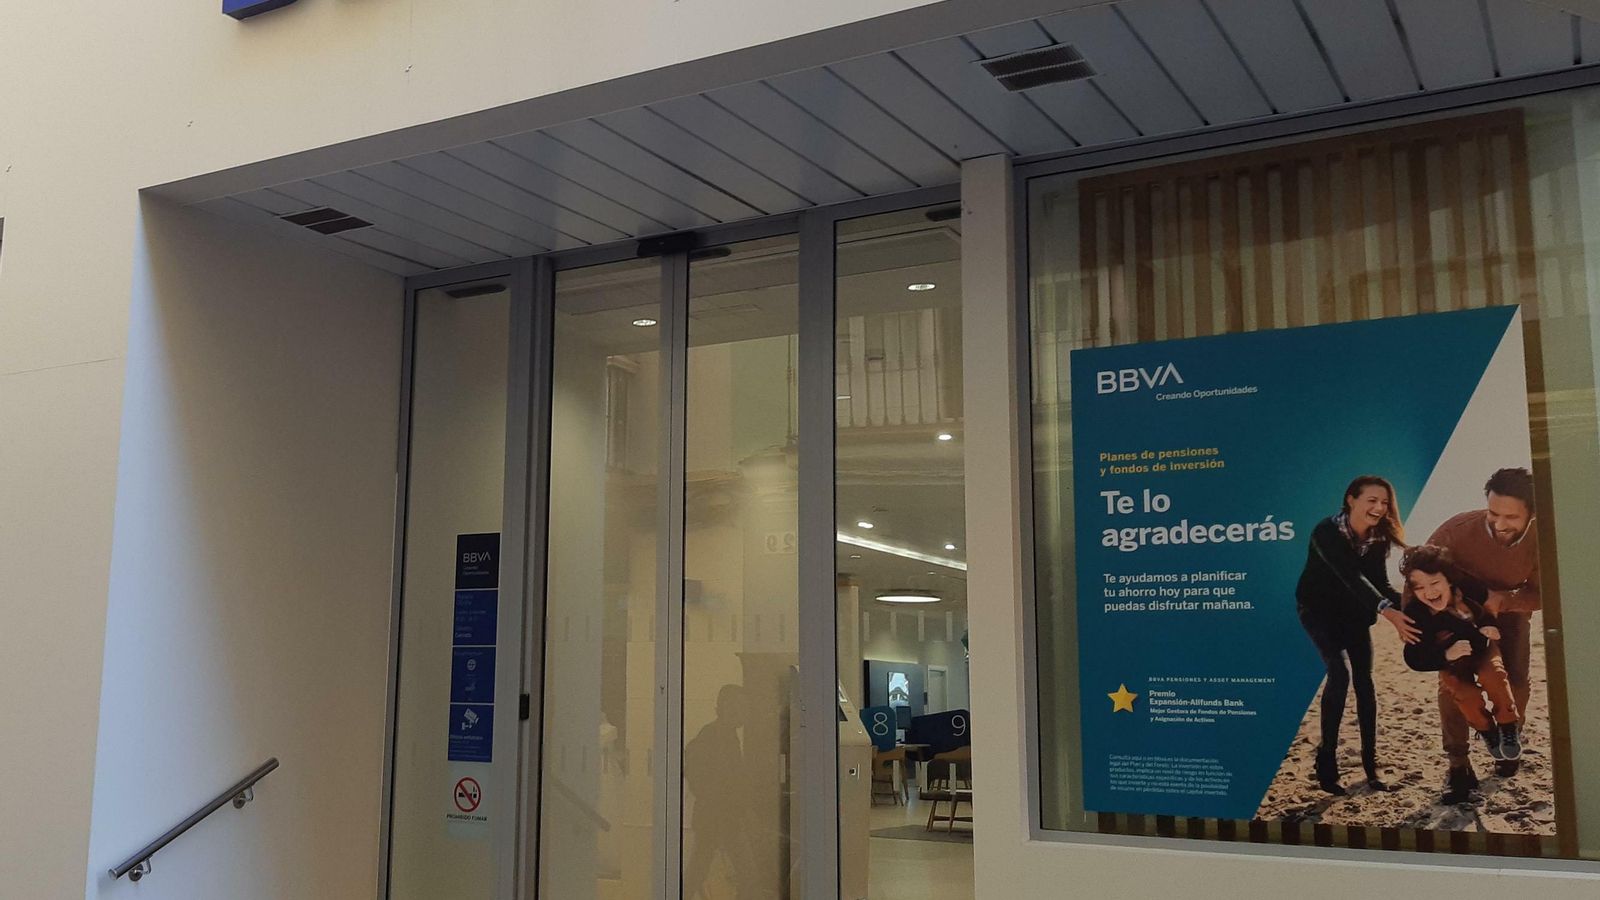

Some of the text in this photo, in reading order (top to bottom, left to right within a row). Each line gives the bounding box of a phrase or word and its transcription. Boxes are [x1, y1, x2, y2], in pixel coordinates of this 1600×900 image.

[1097, 362, 1184, 394] BBVA
[1156, 386, 1258, 401] Creando Oportunidades
[1100, 447, 1219, 462] Planes de pensiones
[1100, 459, 1225, 477] y fondos de inversión
[1100, 488, 1171, 515] Te lo
[1101, 515, 1295, 552] agradecerás
[462, 551, 492, 563] BBVA
[1103, 573, 1116, 583] Te
[1119, 572, 1178, 585] ayudamos
[1191, 571, 1248, 584] planificar
[1103, 586, 1236, 599] tu ahorro hoy para que
[1104, 599, 1255, 613] puedas disfrutar mañana.
[1149, 690, 1176, 698] Premio
[1149, 698, 1245, 707] Expansión-Allfunds Bank
[872, 711, 889, 736] 8
[951, 714, 967, 737] 9
